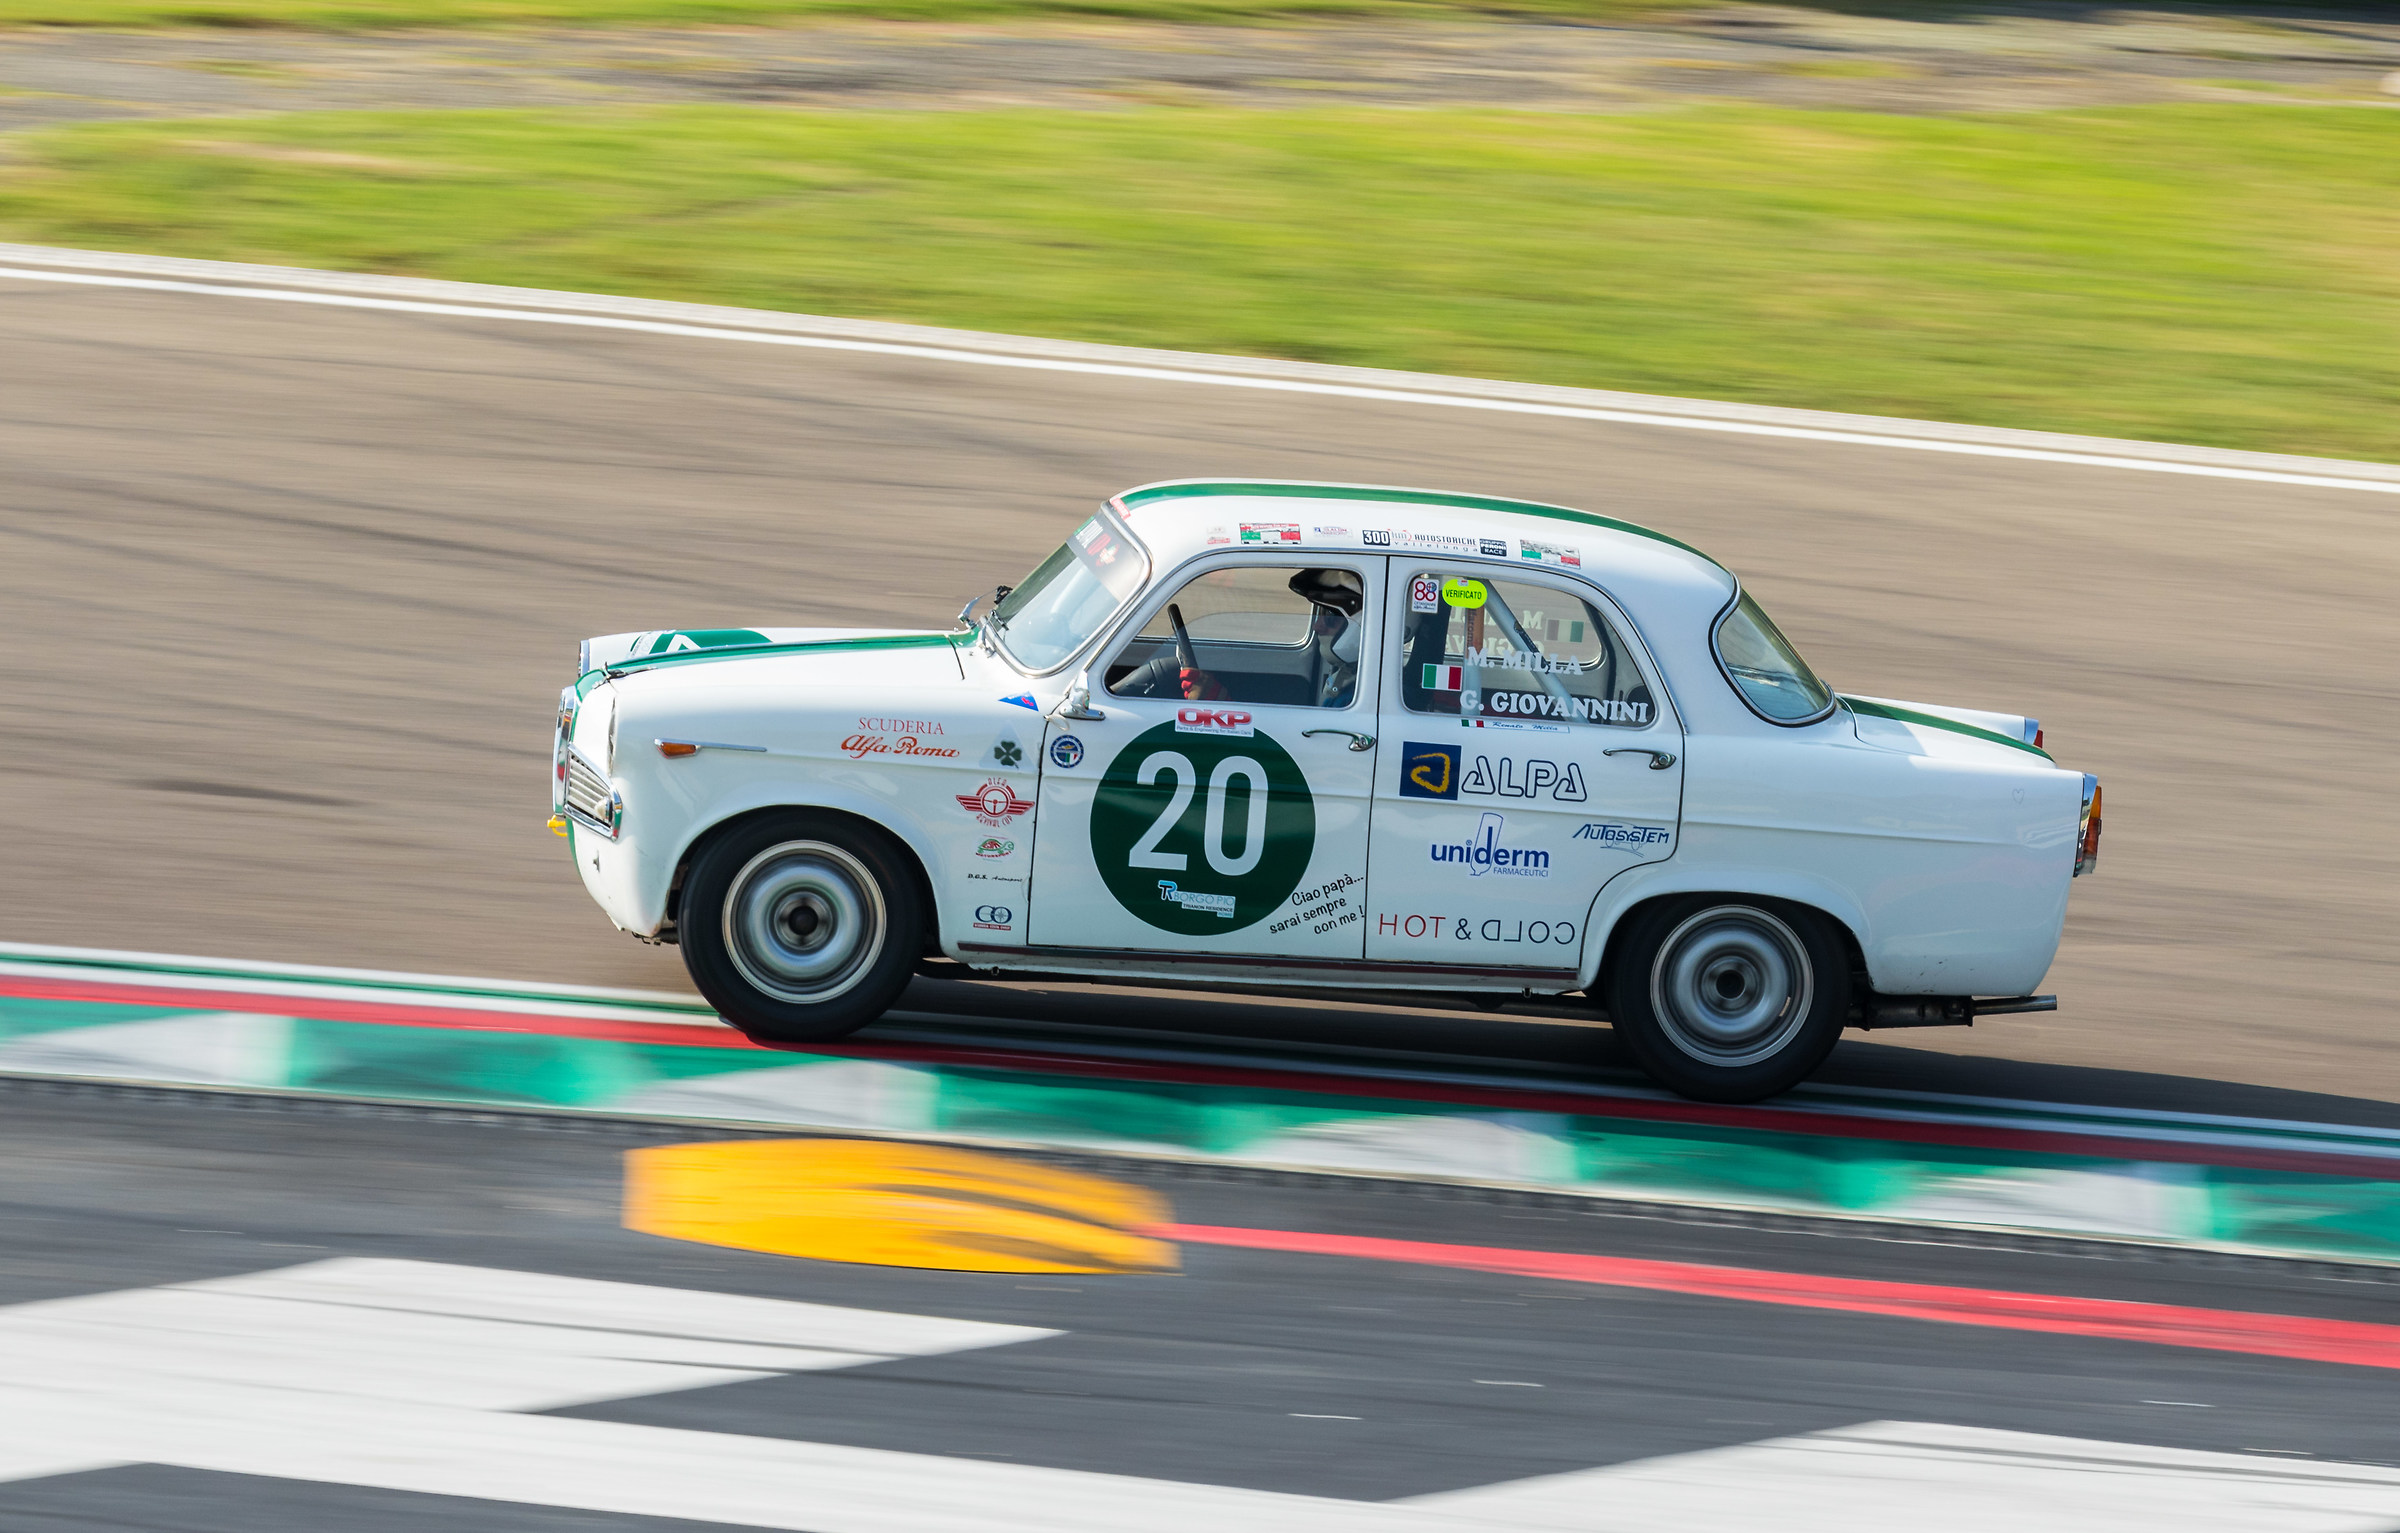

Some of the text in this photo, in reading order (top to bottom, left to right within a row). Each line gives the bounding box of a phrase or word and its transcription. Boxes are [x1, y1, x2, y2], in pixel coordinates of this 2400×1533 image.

[1363, 531, 1390, 545] 300
[1415, 533, 1476, 546] AUTOSTORICHE
[1445, 589, 1482, 600] VERIFICATO
[1466, 646, 1495, 668] M.
[1497, 651, 1584, 676] MILLA
[1177, 707, 1252, 729] OKP
[1460, 689, 1649, 723] G. GIOVANNINI
[858, 717, 944, 736] SCUDERIA
[840, 734, 960, 759] Alfa Roma
[1461, 755, 1588, 802] ALPA
[1129, 750, 1268, 876] 20
[1431, 826, 1550, 868] uniderm
[1493, 866, 1549, 878] FARMACEUTICI
[1173, 892, 1235, 906] BORGO PIO
[1291, 873, 1364, 906] Ciao papà...
[1269, 898, 1347, 934] sarai sempre
[1314, 920, 1338, 934] con
[1338, 912, 1357, 925] me
[1379, 913, 1472, 941] HOT &
